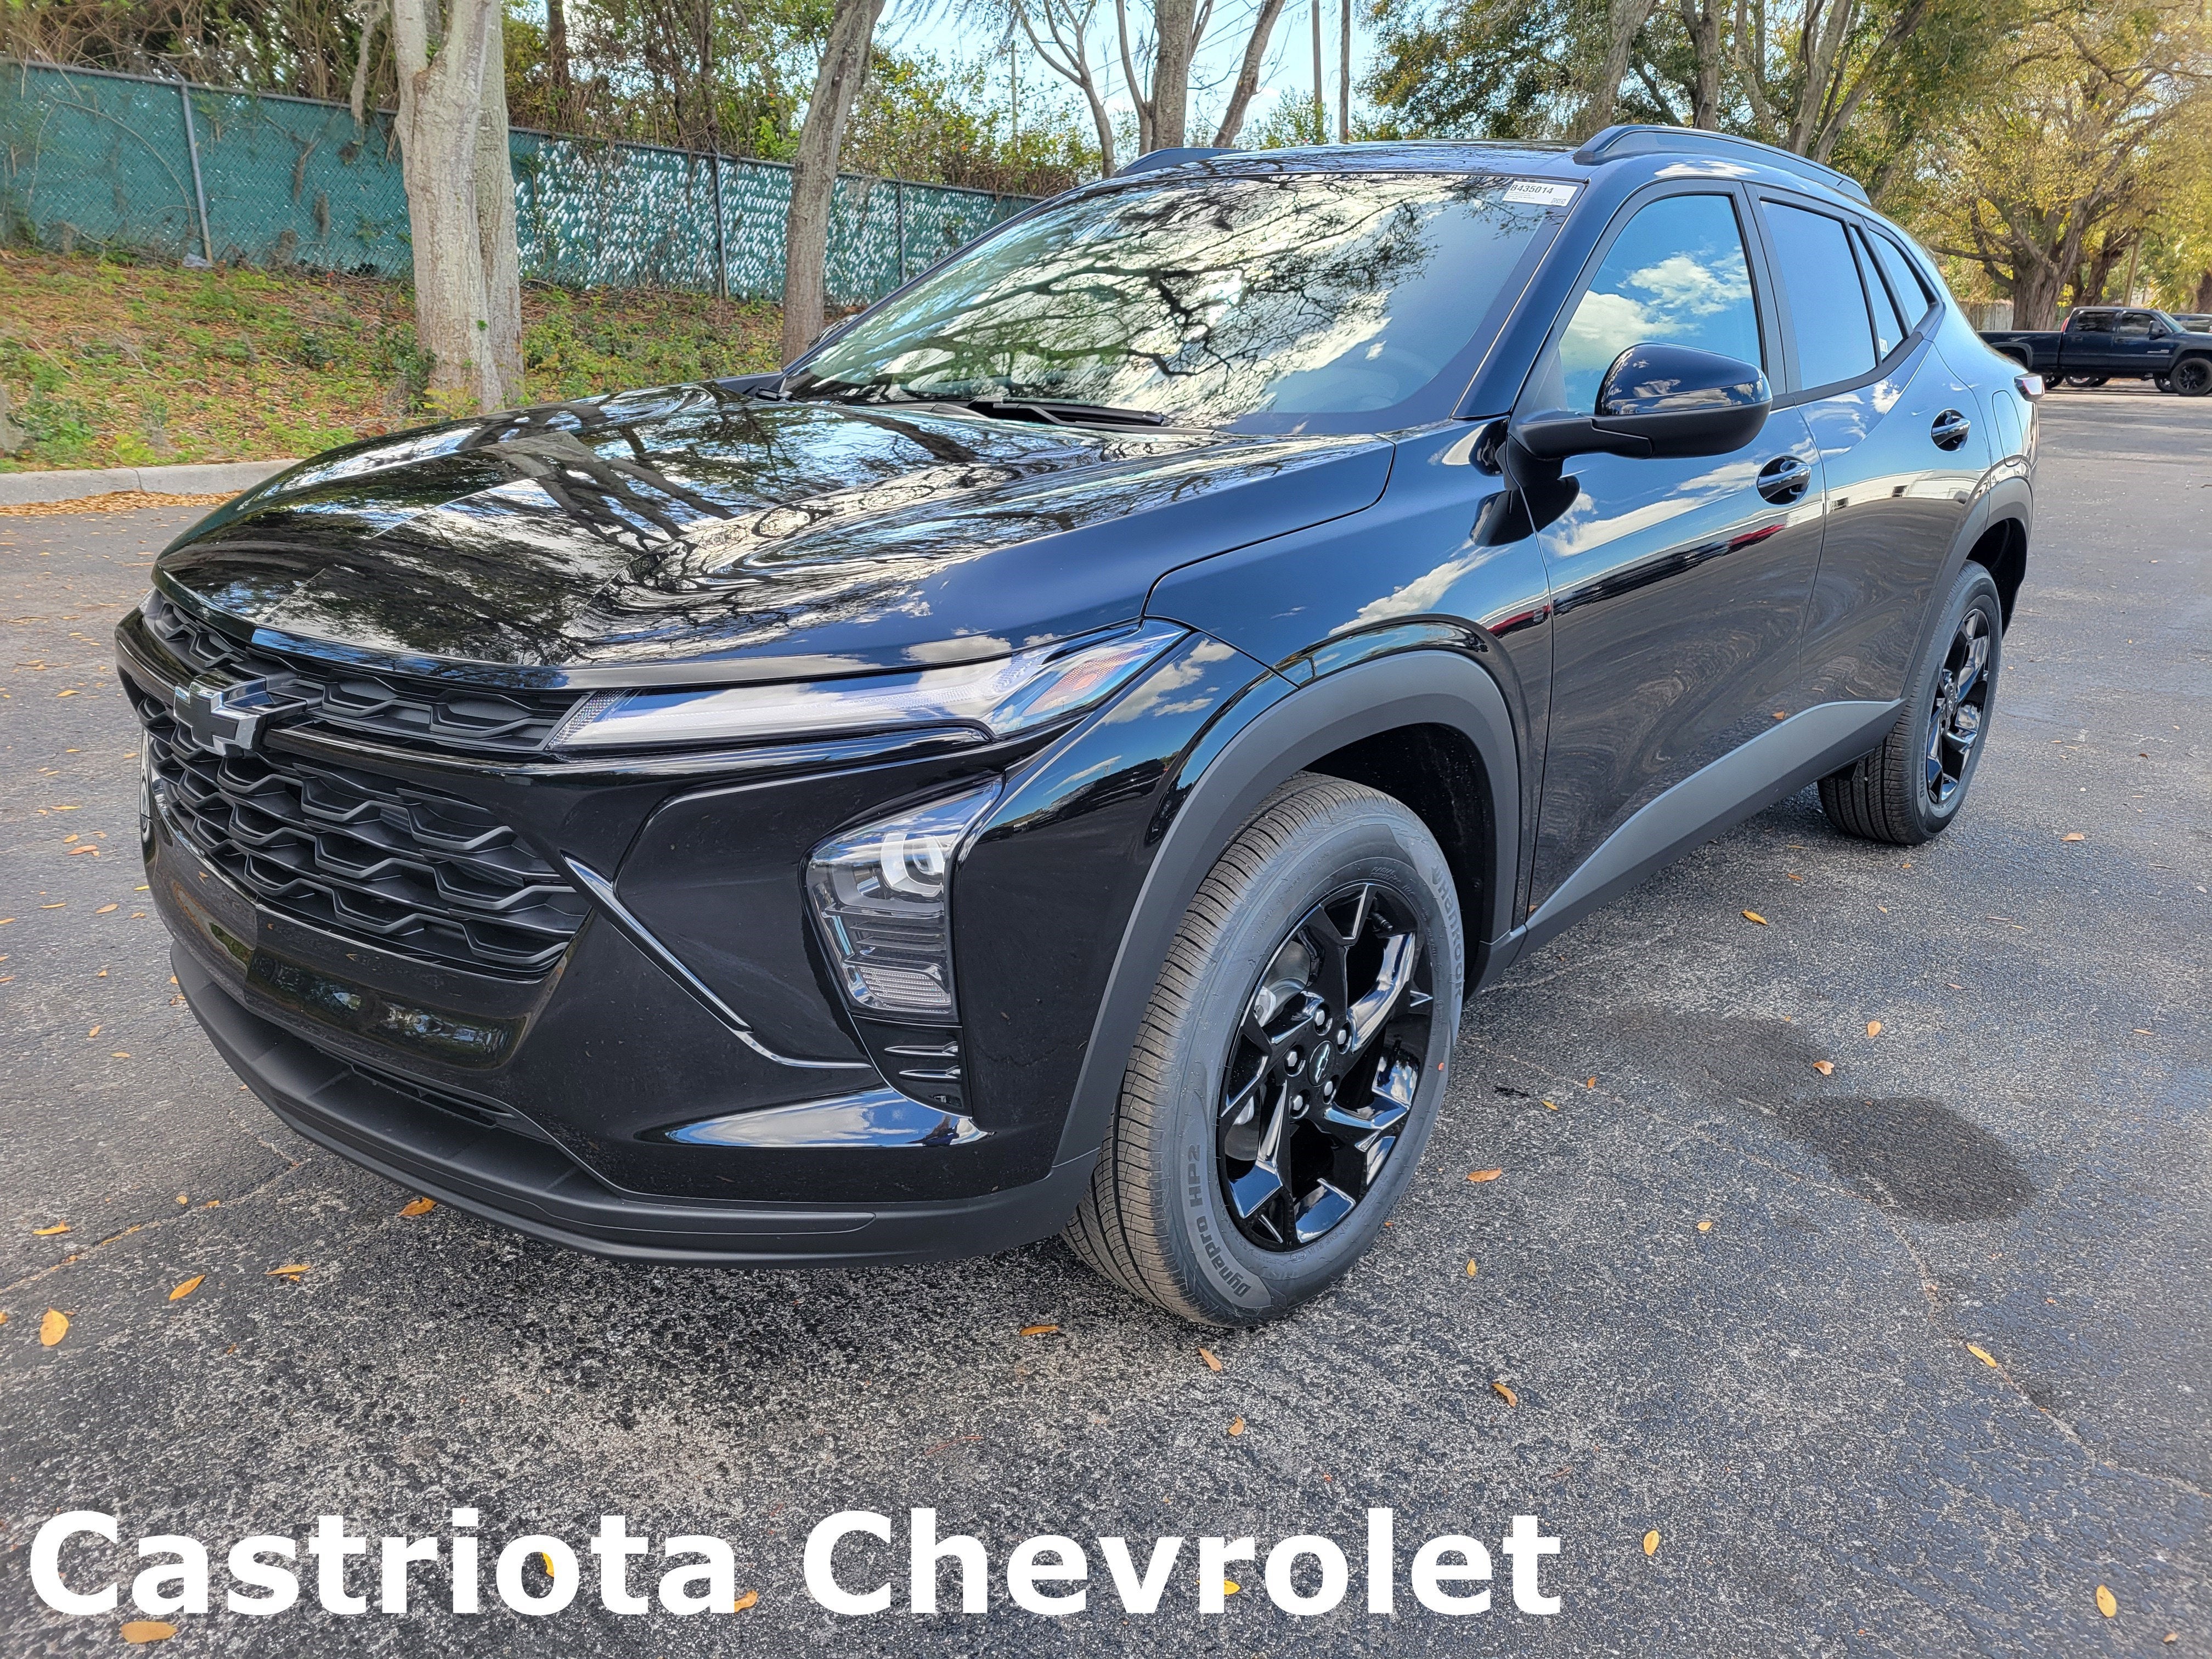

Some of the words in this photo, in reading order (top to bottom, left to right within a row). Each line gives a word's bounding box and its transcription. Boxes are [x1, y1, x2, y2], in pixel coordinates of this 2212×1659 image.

[1510, 184, 1554, 194] B435014
[1188, 1144, 1203, 1207] HP2
[1196, 1215, 1251, 1297] Dynapro
